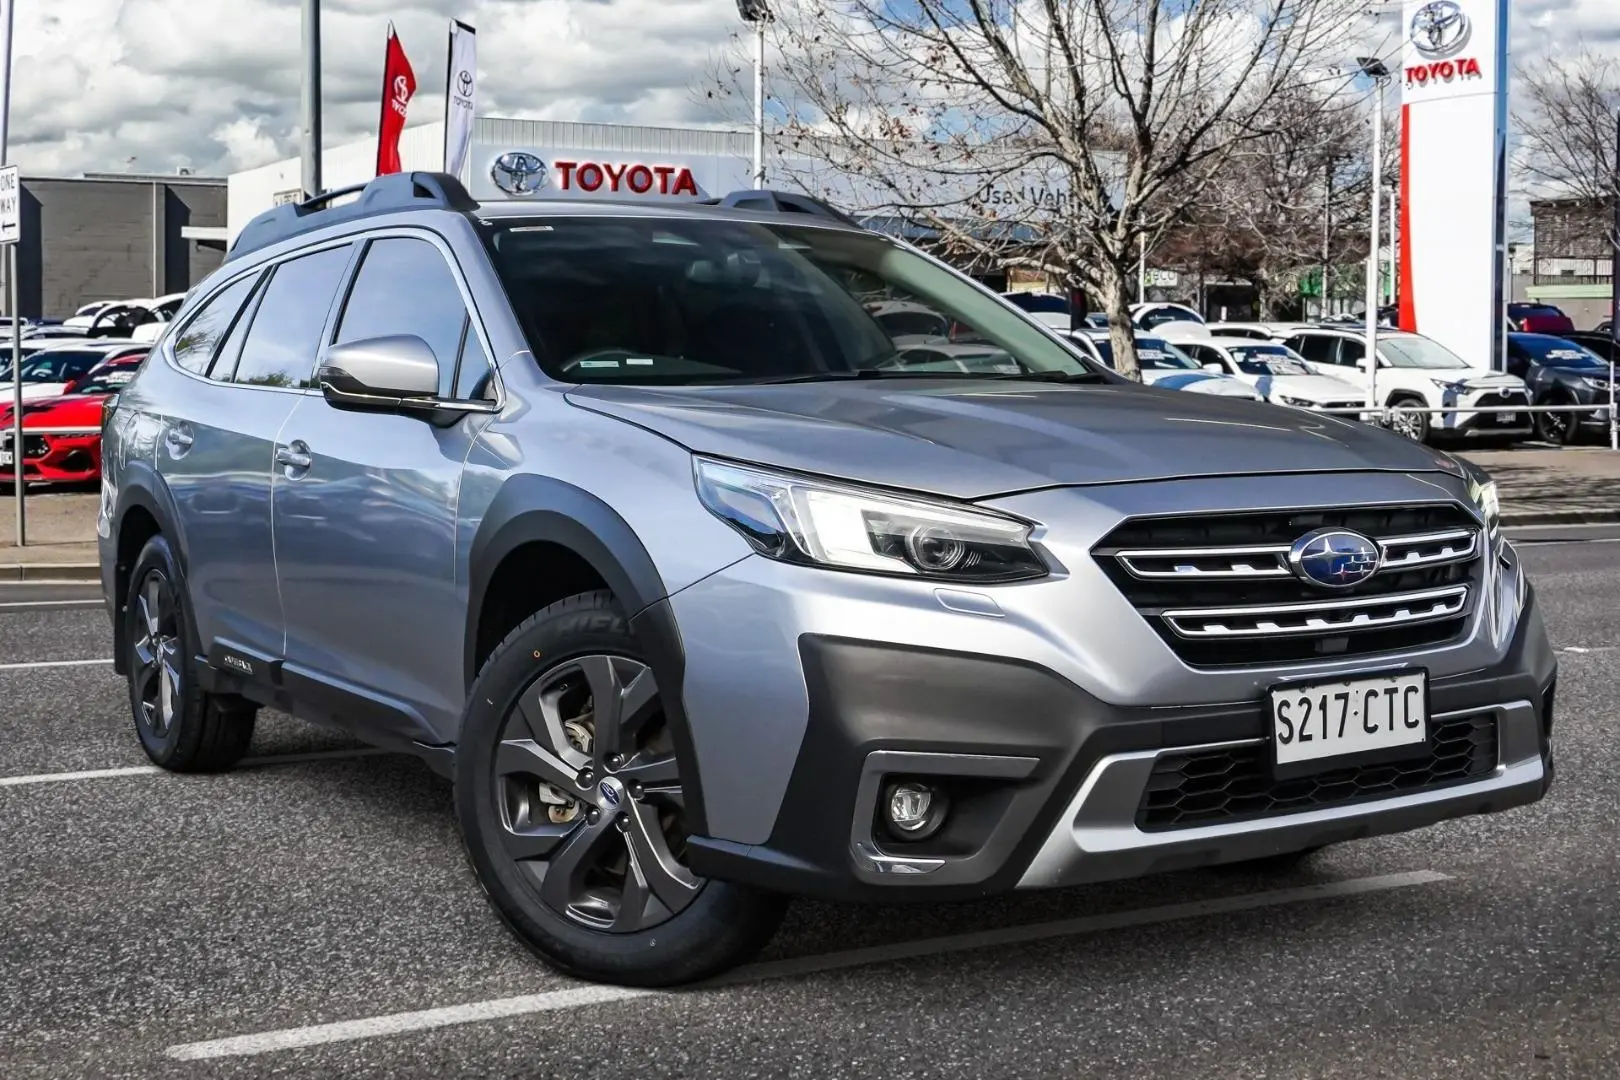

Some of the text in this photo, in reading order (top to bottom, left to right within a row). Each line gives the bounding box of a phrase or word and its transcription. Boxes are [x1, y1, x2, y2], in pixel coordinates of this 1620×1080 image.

[1404, 57, 1481, 84] TOYOTA
[1, 173, 15, 191] ONE
[555, 161, 698, 196] TOYOTA
[0, 196, 16, 214] WAY
